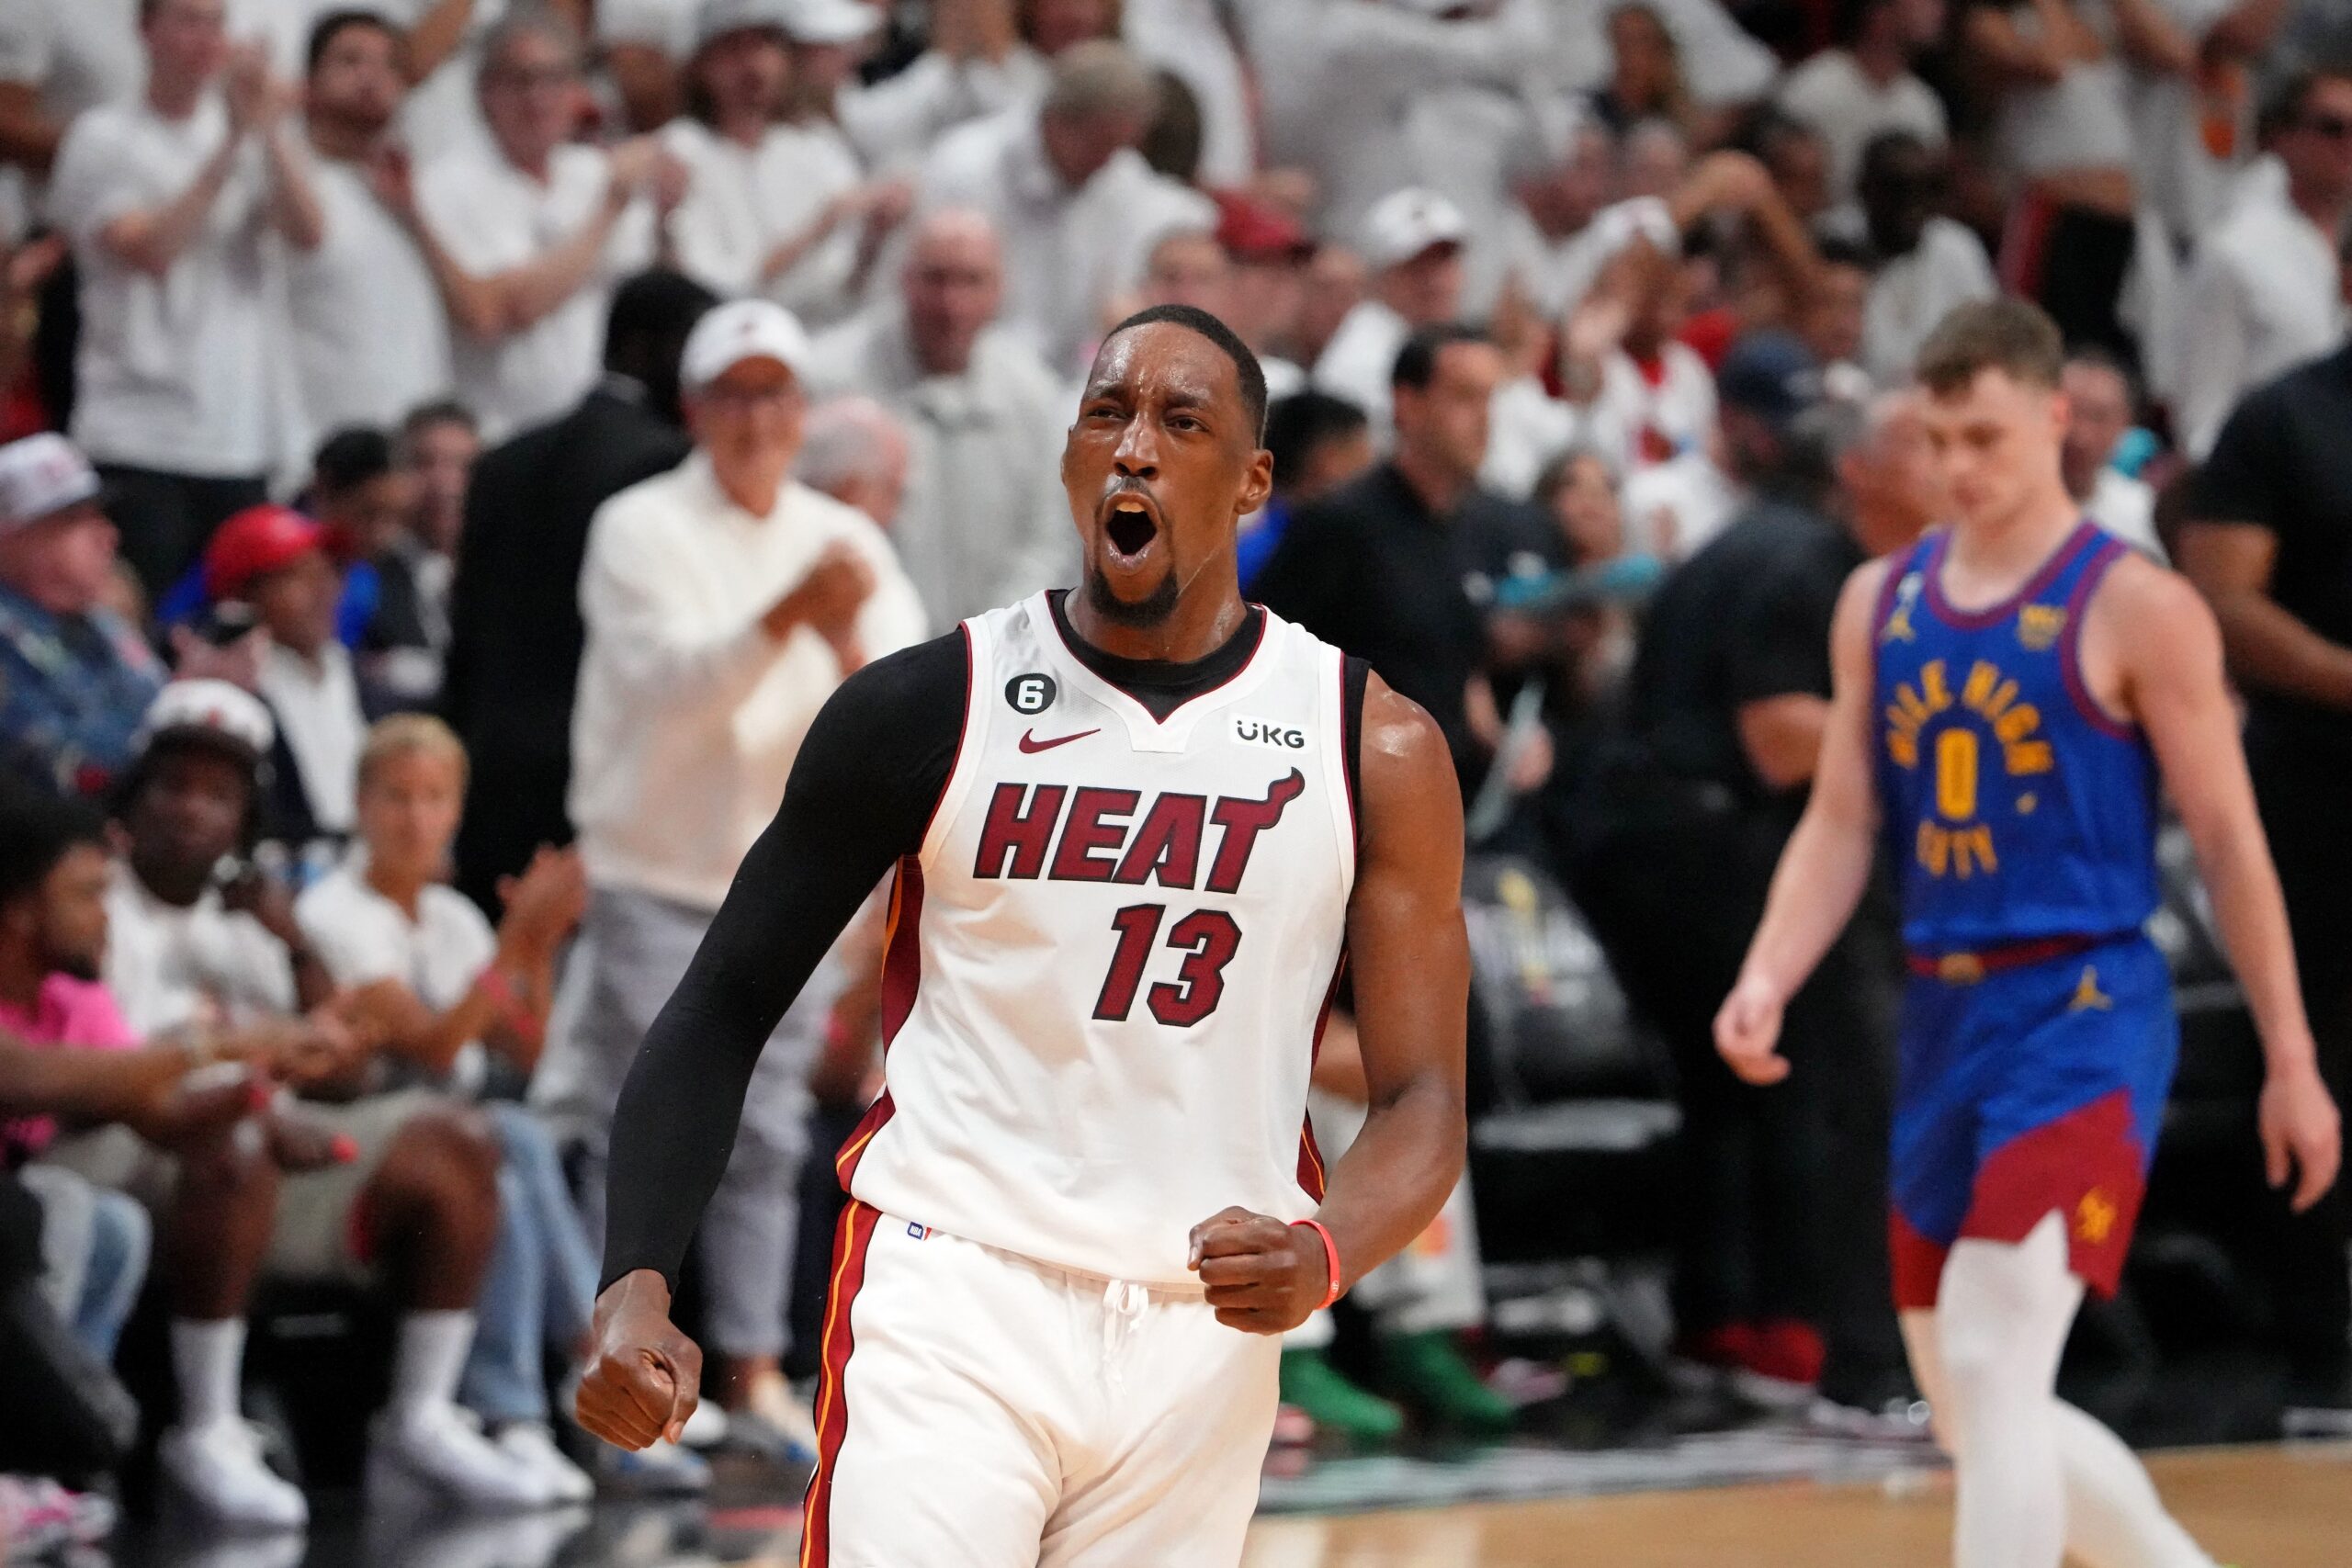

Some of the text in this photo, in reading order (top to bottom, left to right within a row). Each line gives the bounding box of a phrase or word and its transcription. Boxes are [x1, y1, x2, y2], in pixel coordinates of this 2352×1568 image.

[1017, 680, 1045, 709] 6
[1936, 728, 1978, 820] 0
[973, 766, 1306, 895] HEAT
[1091, 903, 1242, 1028] 13
